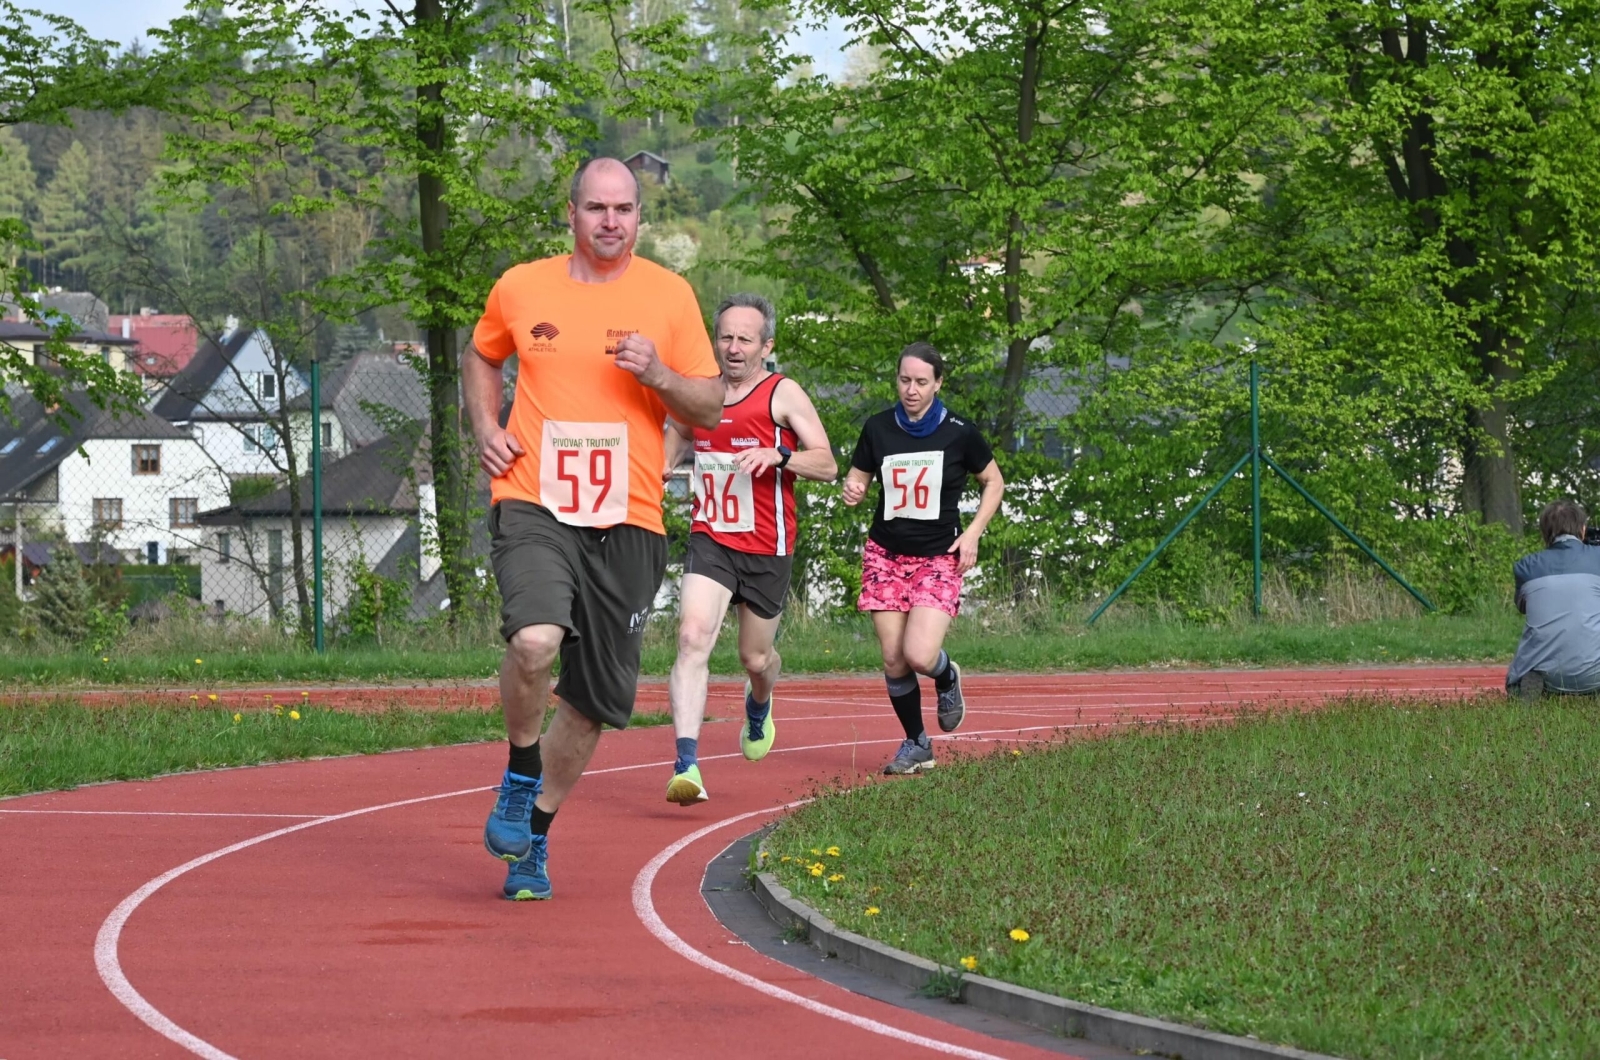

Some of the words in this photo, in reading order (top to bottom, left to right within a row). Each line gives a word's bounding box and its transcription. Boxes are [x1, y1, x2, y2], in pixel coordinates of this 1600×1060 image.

[552, 438, 583, 447] PIVOVAR
[586, 437, 621, 447] TRUTNOV
[557, 449, 612, 513] 59
[702, 472, 740, 523] 86
[892, 467, 929, 511] 56
